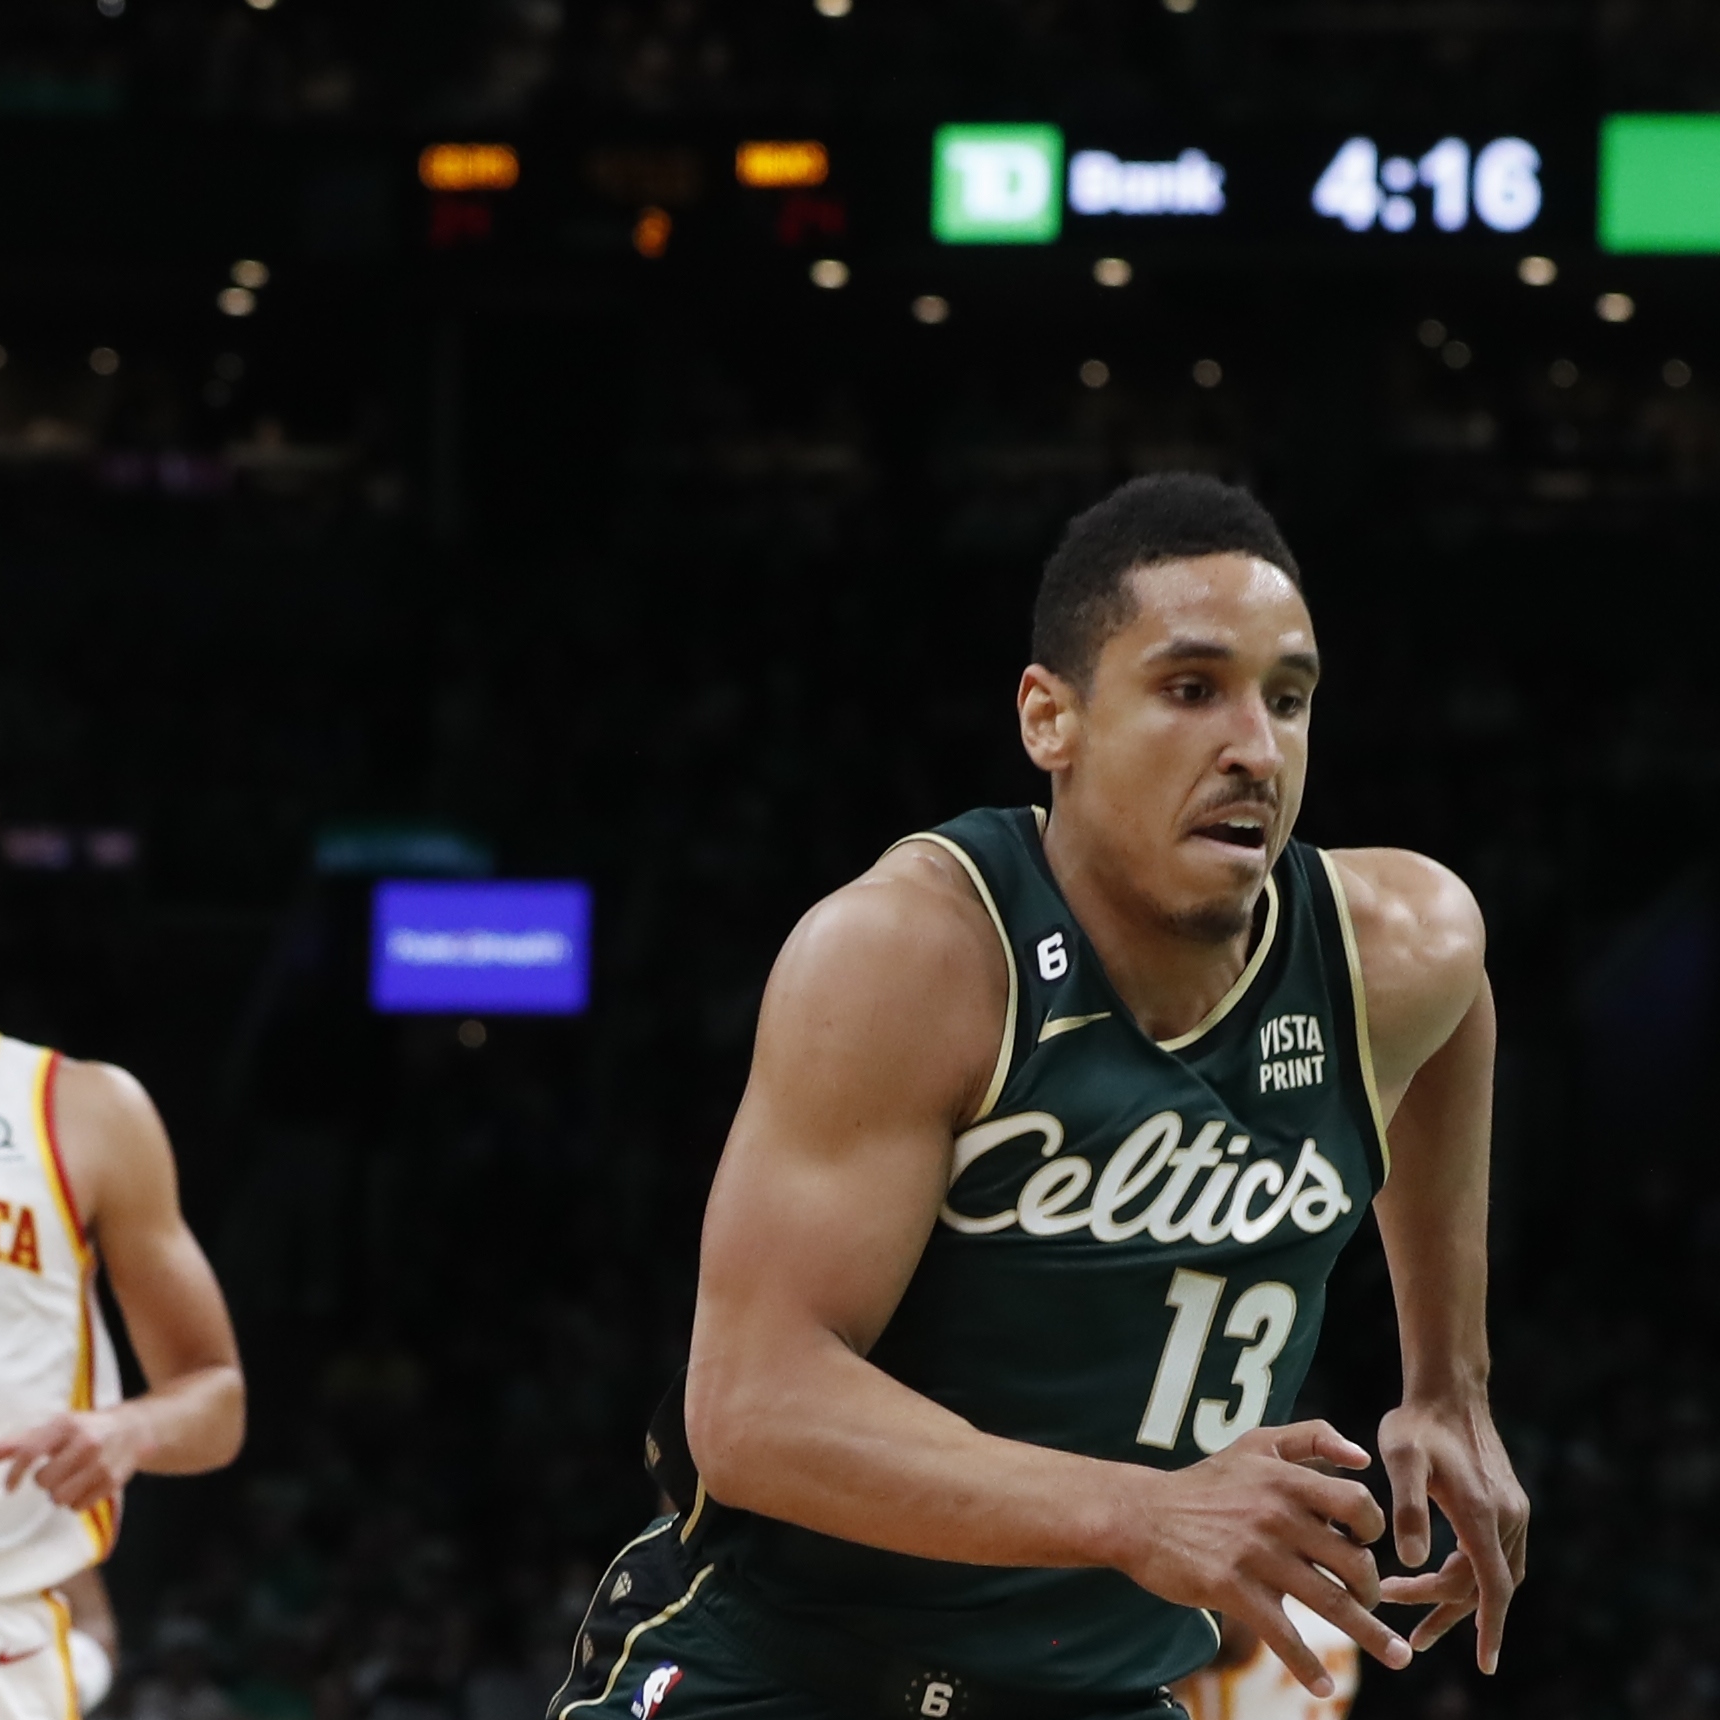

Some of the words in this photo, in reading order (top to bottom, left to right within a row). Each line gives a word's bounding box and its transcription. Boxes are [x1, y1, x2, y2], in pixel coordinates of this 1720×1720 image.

[943, 140, 1051, 222] TD
[1068, 147, 1226, 216] Bank
[1311, 135, 1543, 233] 4:16
[1037, 931, 1068, 981] 6
[1260, 1014, 1324, 1061] VISTA
[1260, 1054, 1326, 1094] PRINT
[939, 1111, 1352, 1243] Celtics
[1136, 1267, 1297, 1454] 13
[921, 1681, 954, 1718] 6
